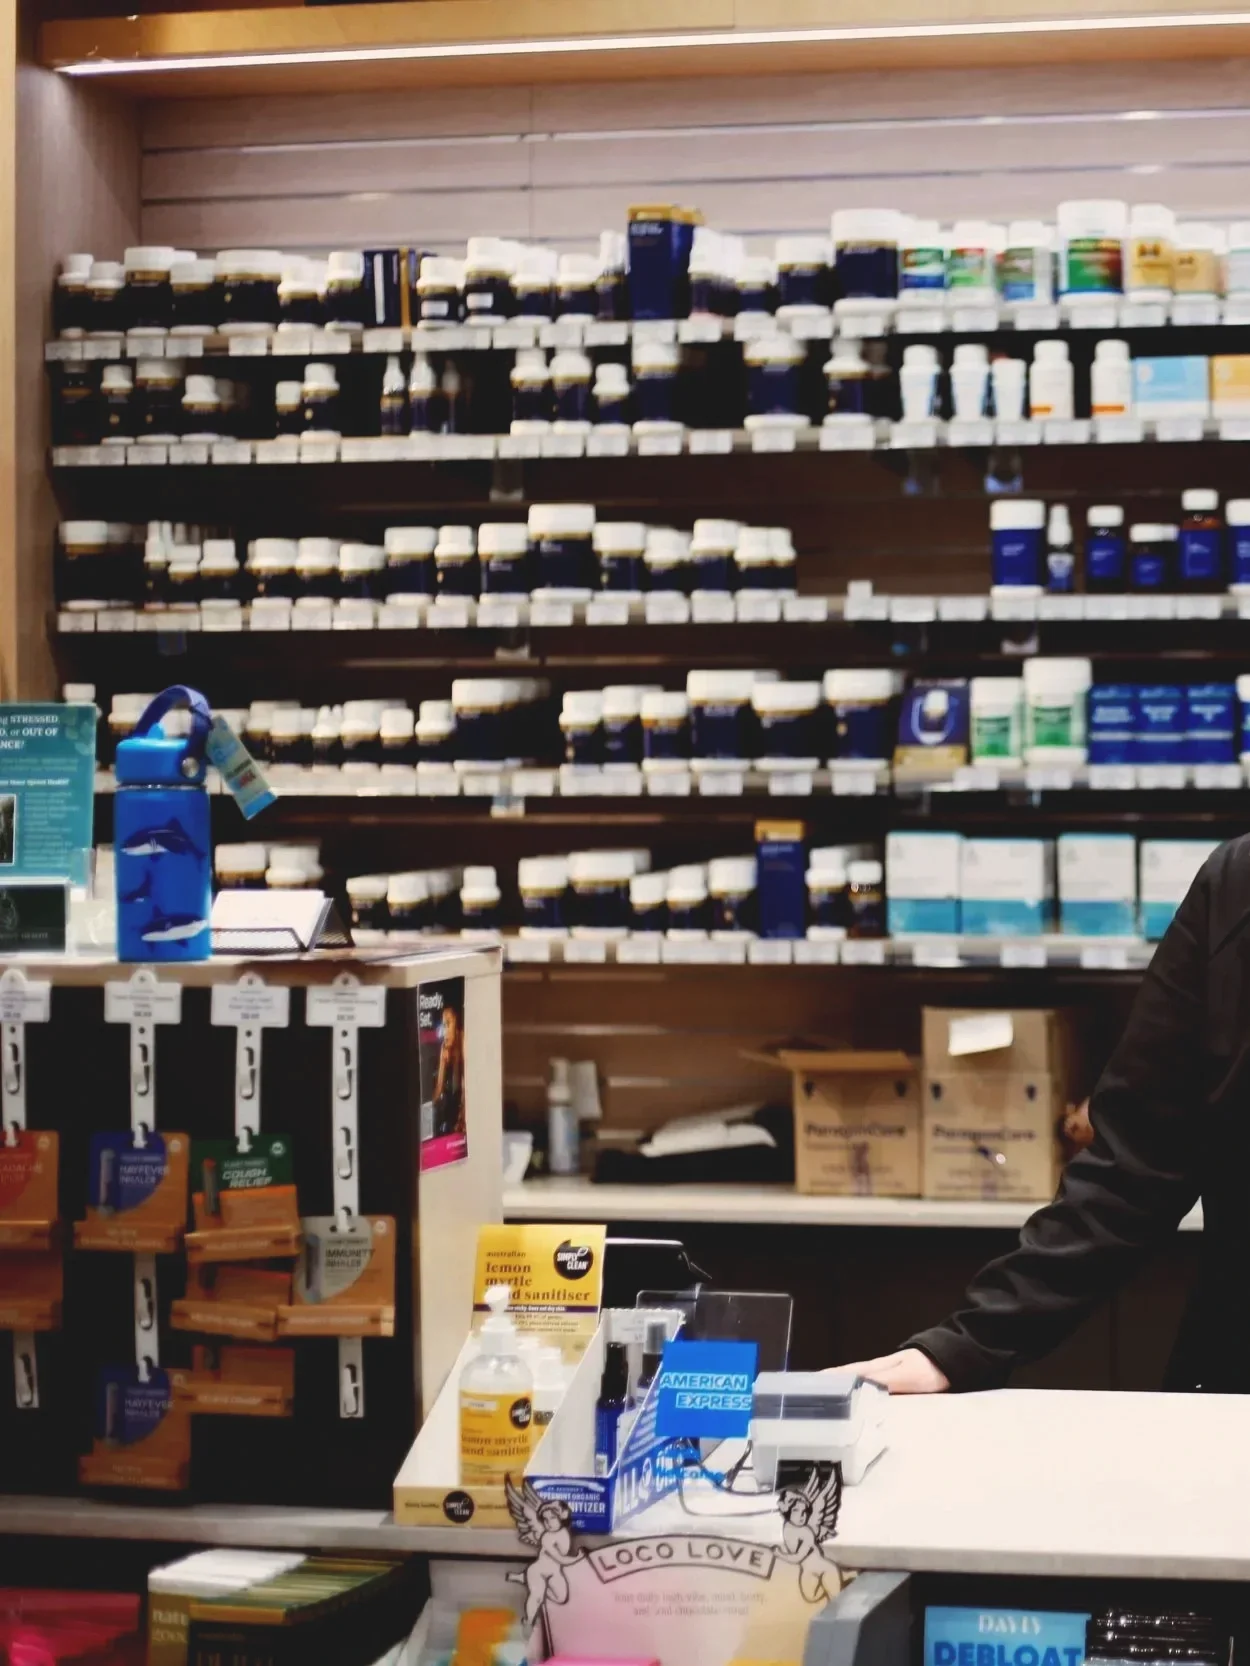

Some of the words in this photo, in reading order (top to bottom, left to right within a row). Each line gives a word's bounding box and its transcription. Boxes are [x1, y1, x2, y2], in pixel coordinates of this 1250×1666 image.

[22, 727, 43, 737] OUT
[222, 1168, 267, 1181] COUGH
[228, 1176, 272, 1189] RELIEF
[326, 1248, 376, 1259] IMMUNITY
[557, 1251, 578, 1262] SIMPLY
[486, 1261, 531, 1274] lemon
[567, 1261, 588, 1270] CLEAN
[484, 1275, 532, 1288] myrtle
[524, 1288, 590, 1301] sanitiser
[660, 1372, 748, 1390] AMERICAN
[676, 1392, 752, 1411] EXPRESS
[572, 1492, 600, 1501] ORGANIC
[567, 1501, 605, 1514] NITIZER
[598, 1542, 674, 1571] LOCO
[687, 1541, 765, 1568] LOVE
[933, 1641, 1082, 1666] DEBLOAT
